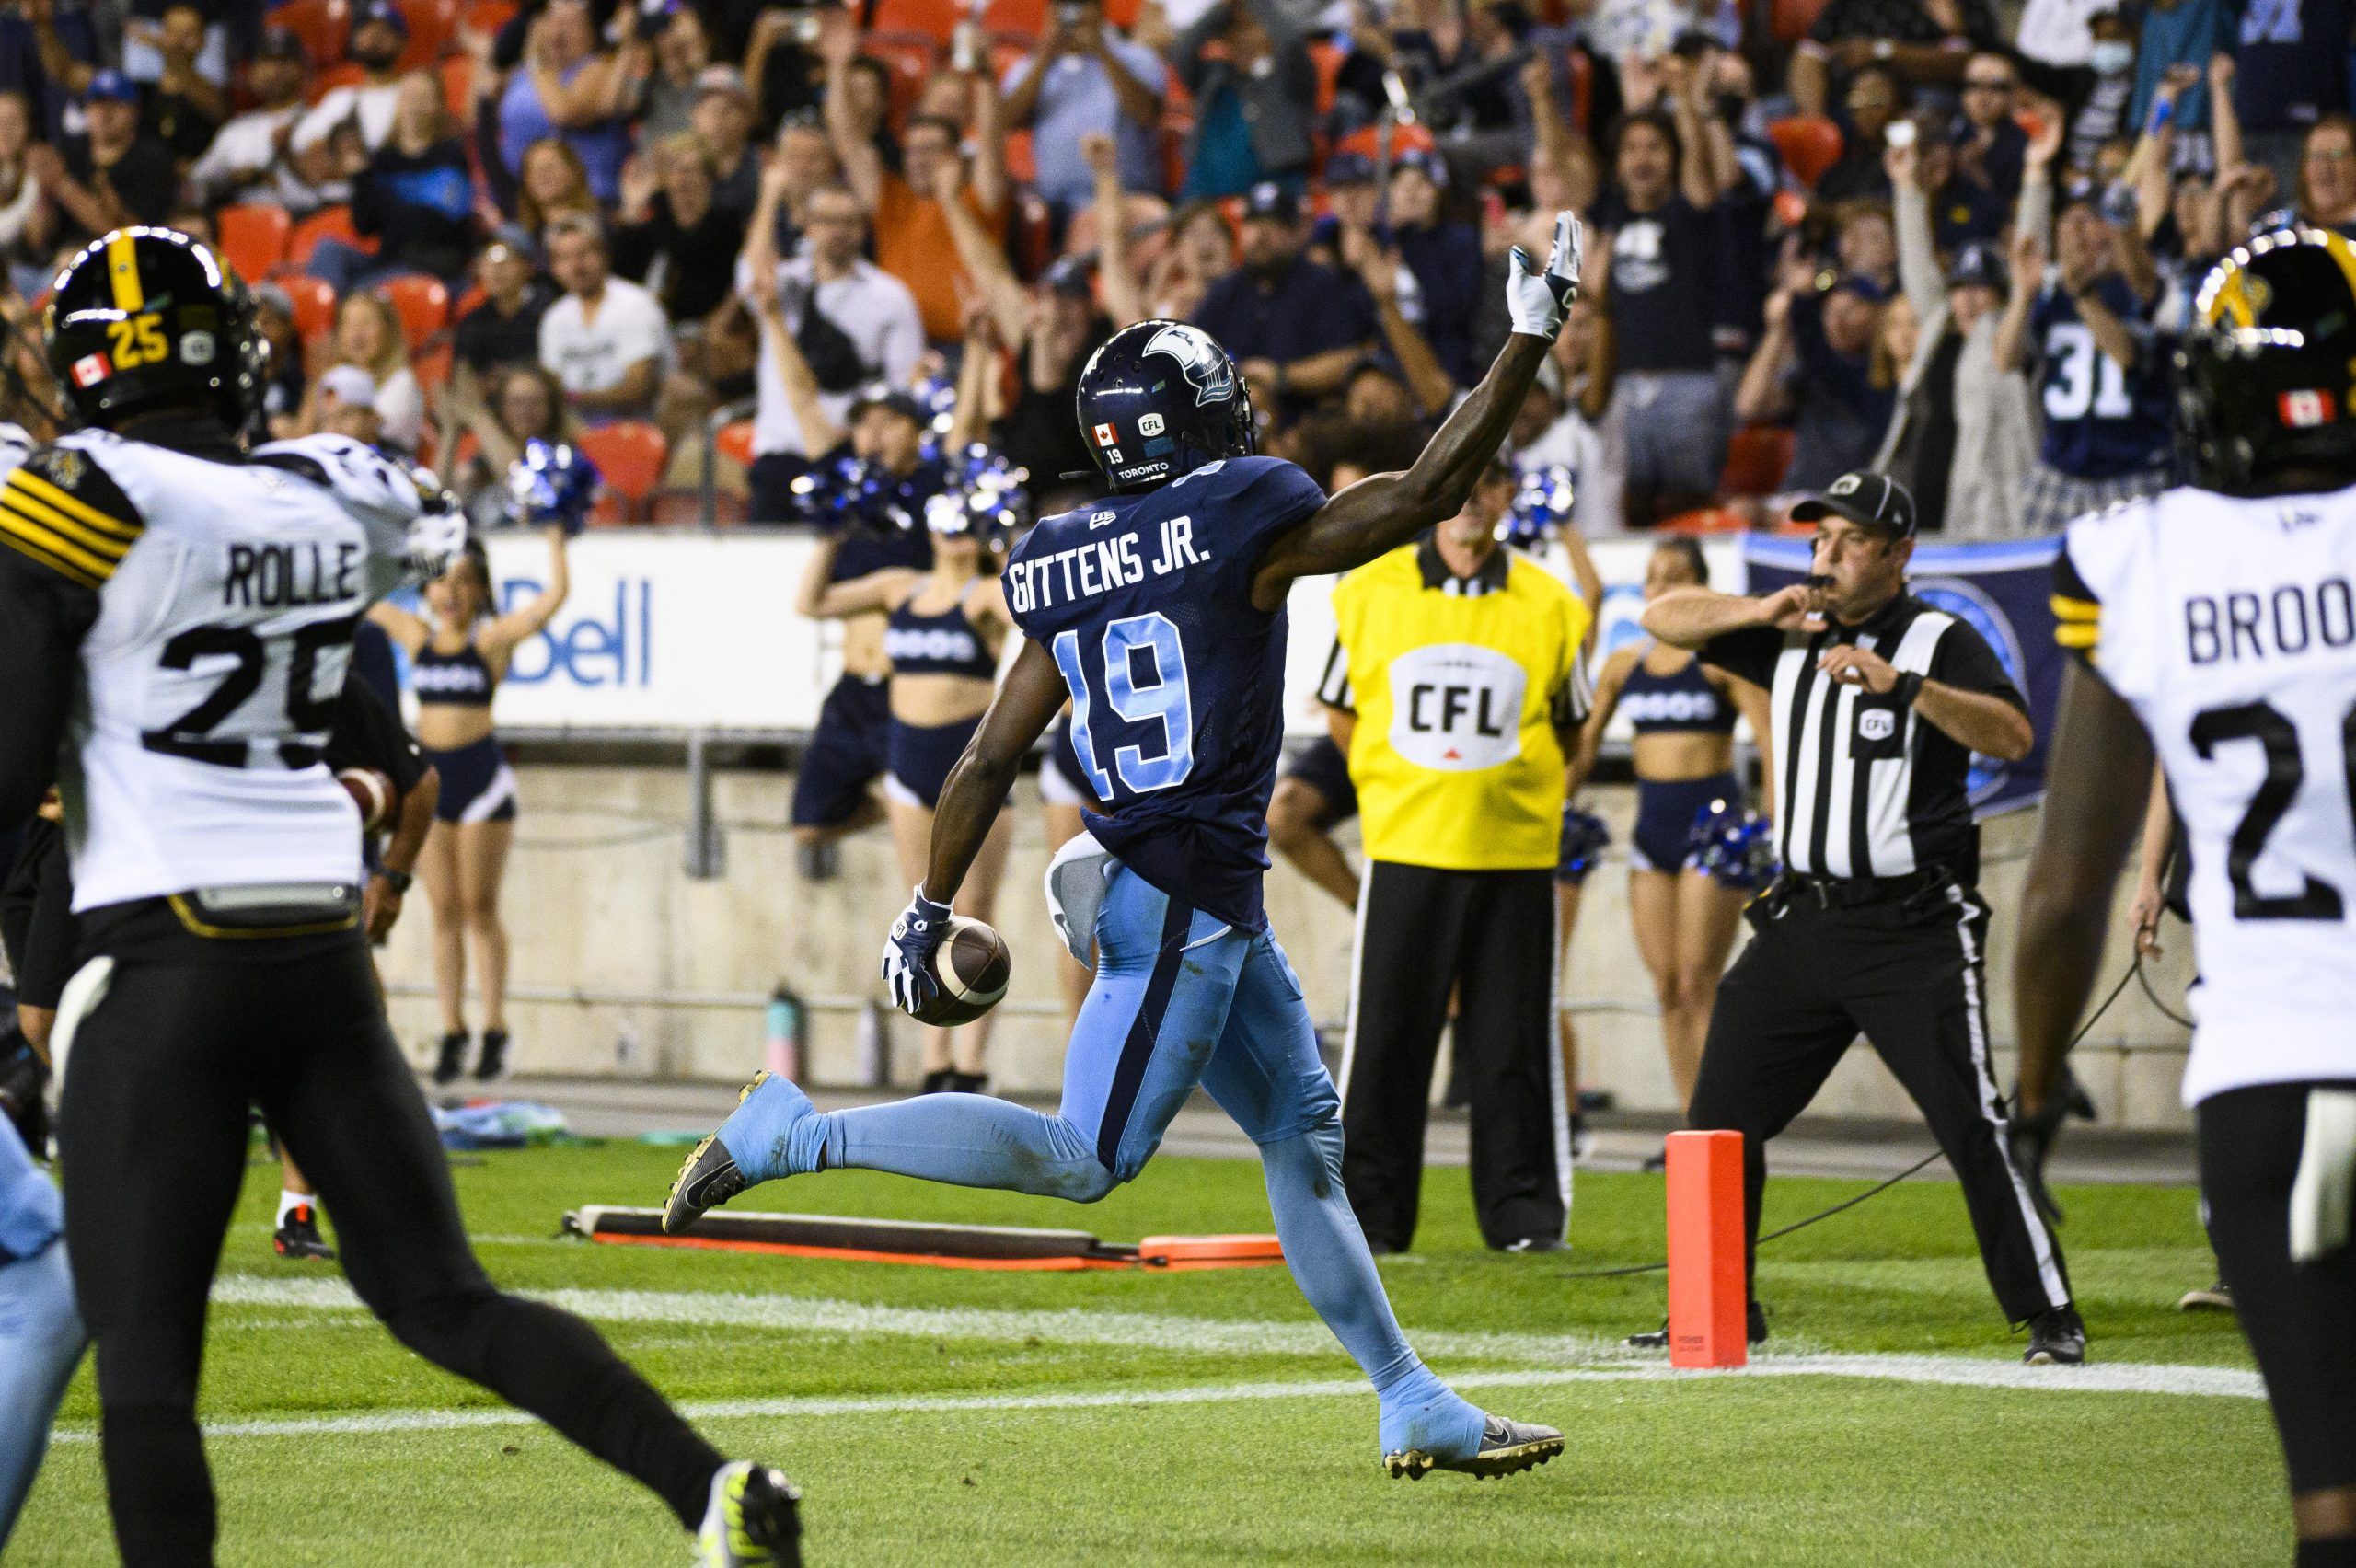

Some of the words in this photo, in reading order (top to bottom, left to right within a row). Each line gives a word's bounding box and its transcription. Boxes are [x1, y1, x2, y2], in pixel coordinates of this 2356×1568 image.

[107, 313, 169, 370] 25
[2044, 323, 2132, 420] 31
[1106, 448, 1123, 464] 19
[1142, 420, 1161, 431] CFL
[1118, 462, 1169, 478] TORONTO
[224, 542, 359, 607] ROLLE
[1009, 532, 1144, 614] GITTENS
[1152, 515, 1211, 576] JR.
[502, 578, 651, 686] Bell
[2186, 576, 2356, 664] BROO
[1052, 610, 1195, 801] 19
[1410, 683, 1503, 736] CFL
[2189, 697, 2356, 921] 2
